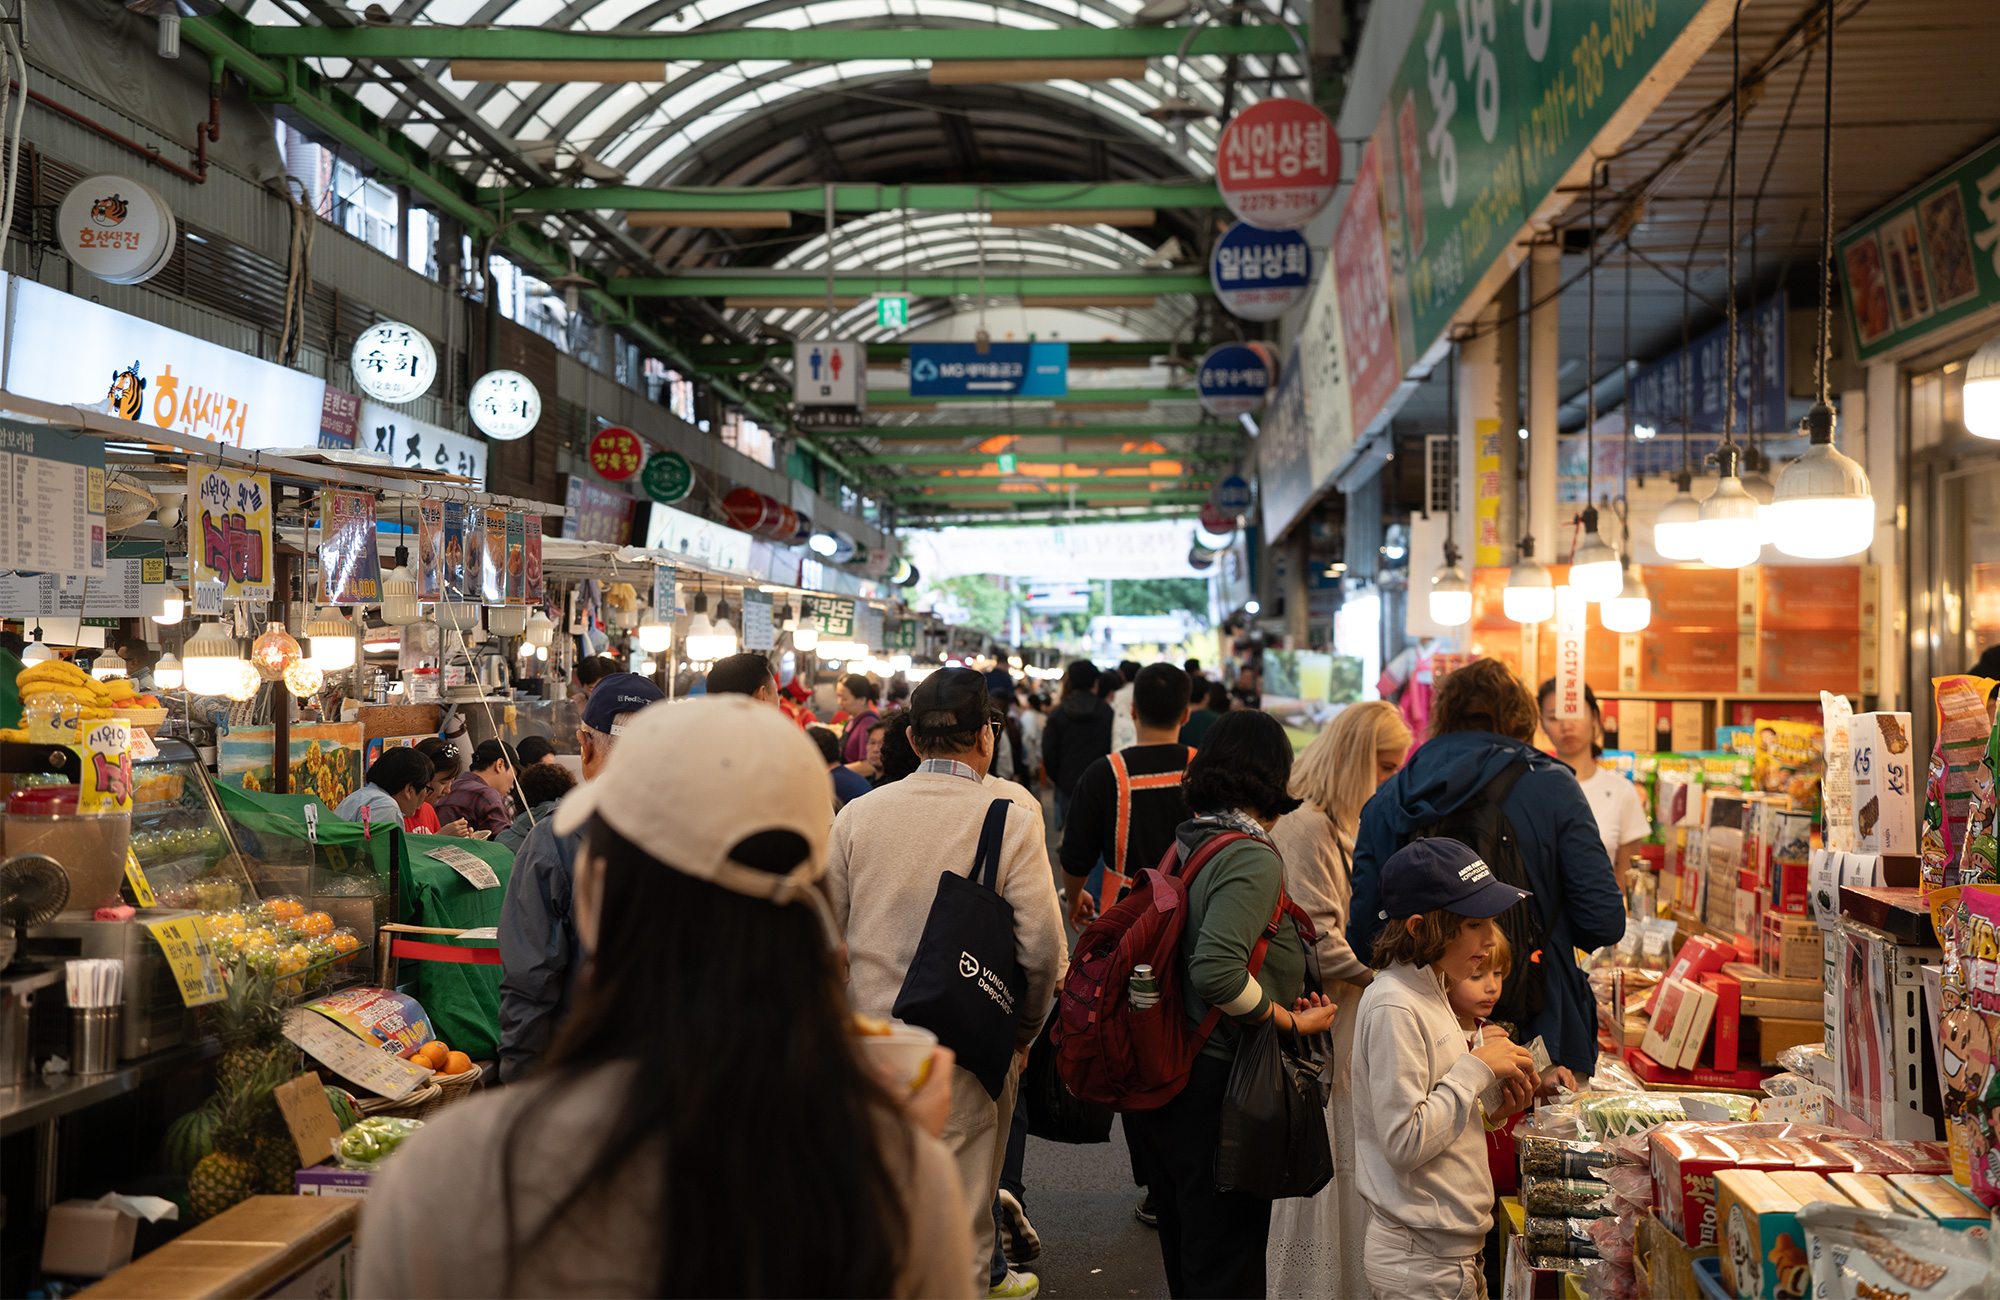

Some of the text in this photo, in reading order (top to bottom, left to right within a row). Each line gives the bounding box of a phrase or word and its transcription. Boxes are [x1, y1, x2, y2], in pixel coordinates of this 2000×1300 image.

[1226, 119, 1328, 180] 신안상회
[78, 226, 141, 251] 호선생전
[1217, 242, 1307, 282] 일심상회
[375, 328, 413, 347] 진주
[360, 350, 419, 378] 육회
[939, 362, 964, 378] MG
[964, 362, 1023, 379] 새마을금고
[490, 378, 520, 393] 진주
[477, 396, 528, 420] 육회
[200, 474, 263, 513] 시원한 옛날
[498, 518, 506, 530] 빙수
[202, 508, 263, 592] 식혜
[90, 725, 128, 750] 시원한
[92, 750, 132, 807] 식
[1888, 763, 1904, 796] X-5
[982, 966, 1004, 991] VUNO
[1972, 987, 2000, 1012] PIN
[1683, 1173, 1715, 1204] 情
